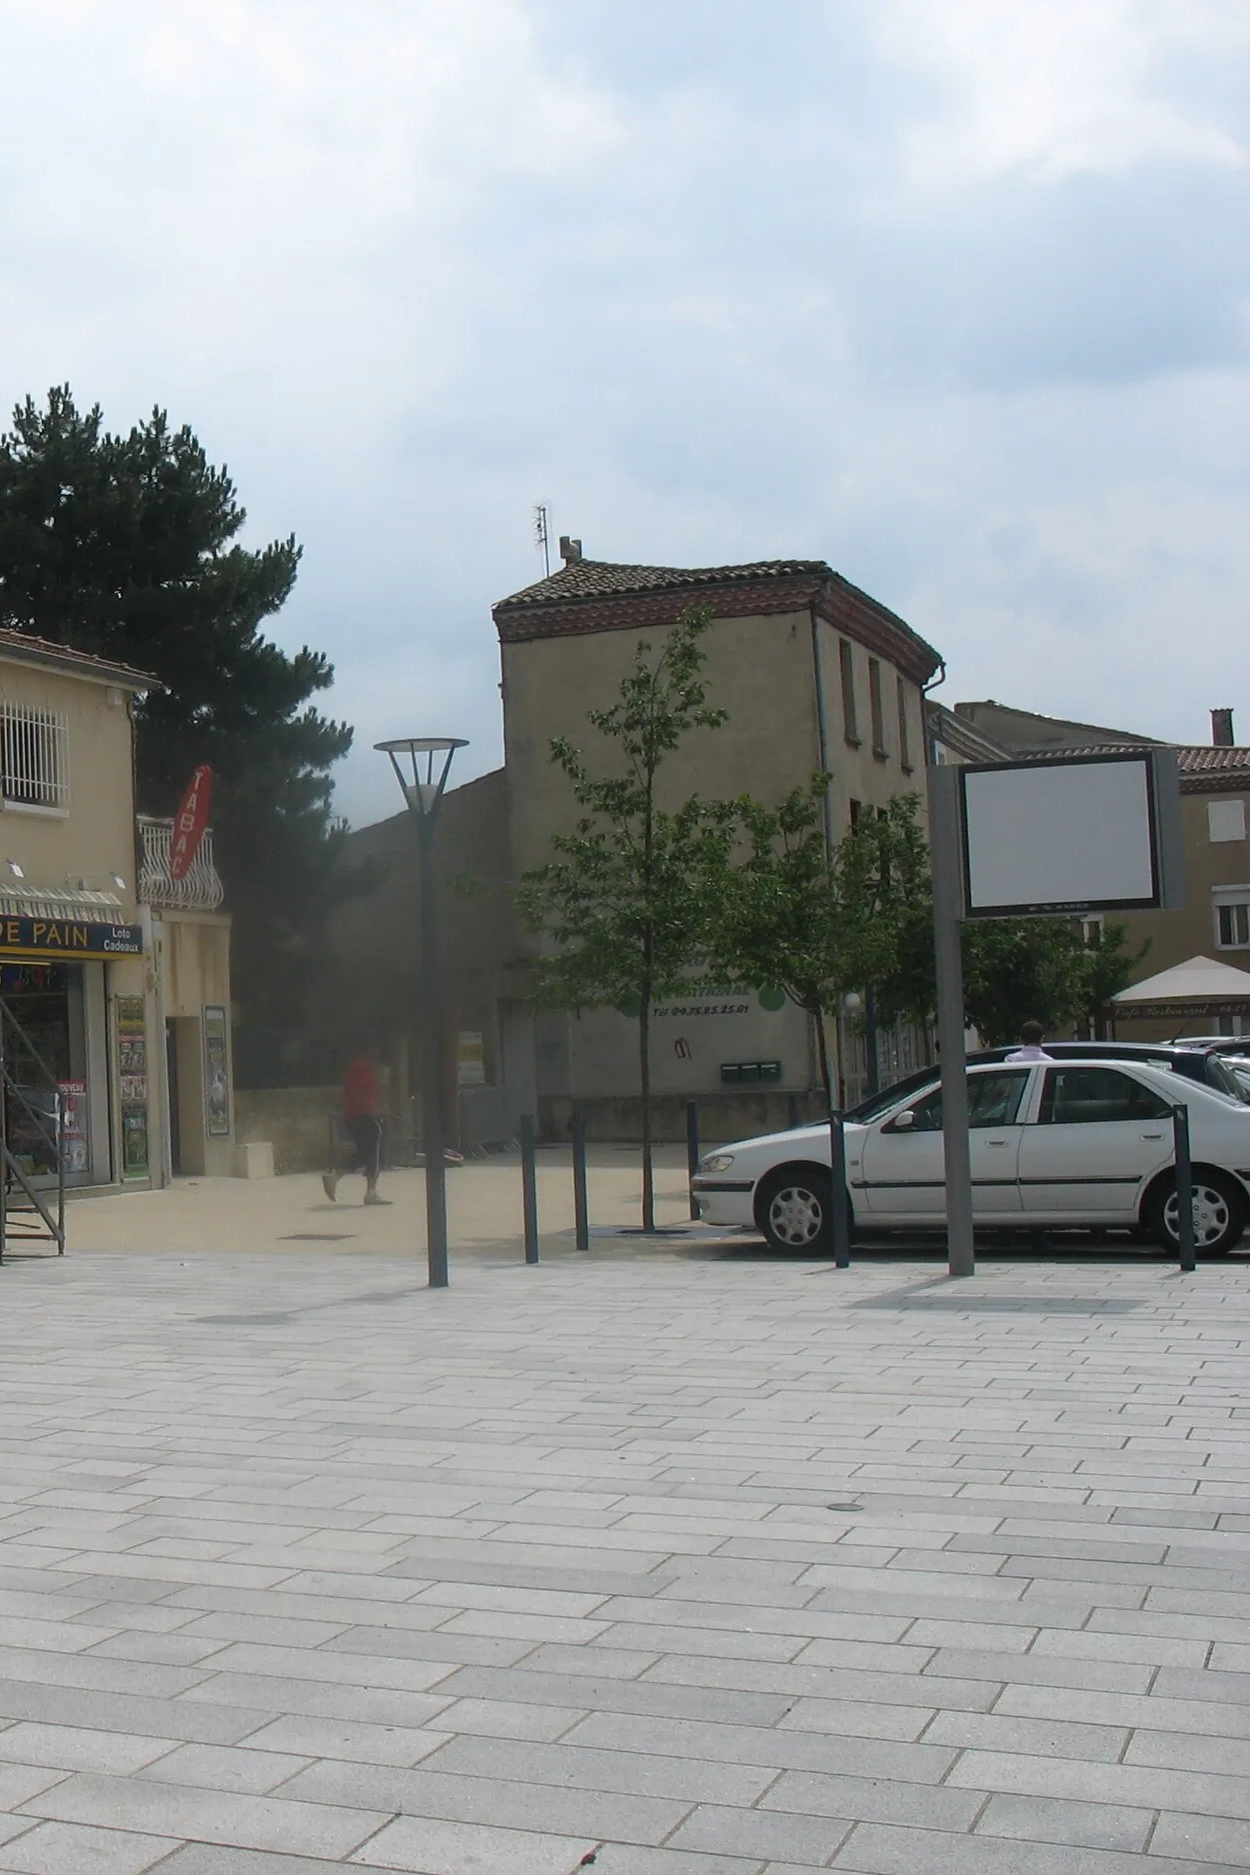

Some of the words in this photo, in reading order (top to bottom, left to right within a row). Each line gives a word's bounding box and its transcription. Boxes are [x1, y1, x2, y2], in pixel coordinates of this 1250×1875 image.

[172, 771, 204, 874] TABAC
[33, 923, 88, 947] PAIN
[112, 927, 131, 939] Loto
[103, 939, 139, 952] Cadeaux
